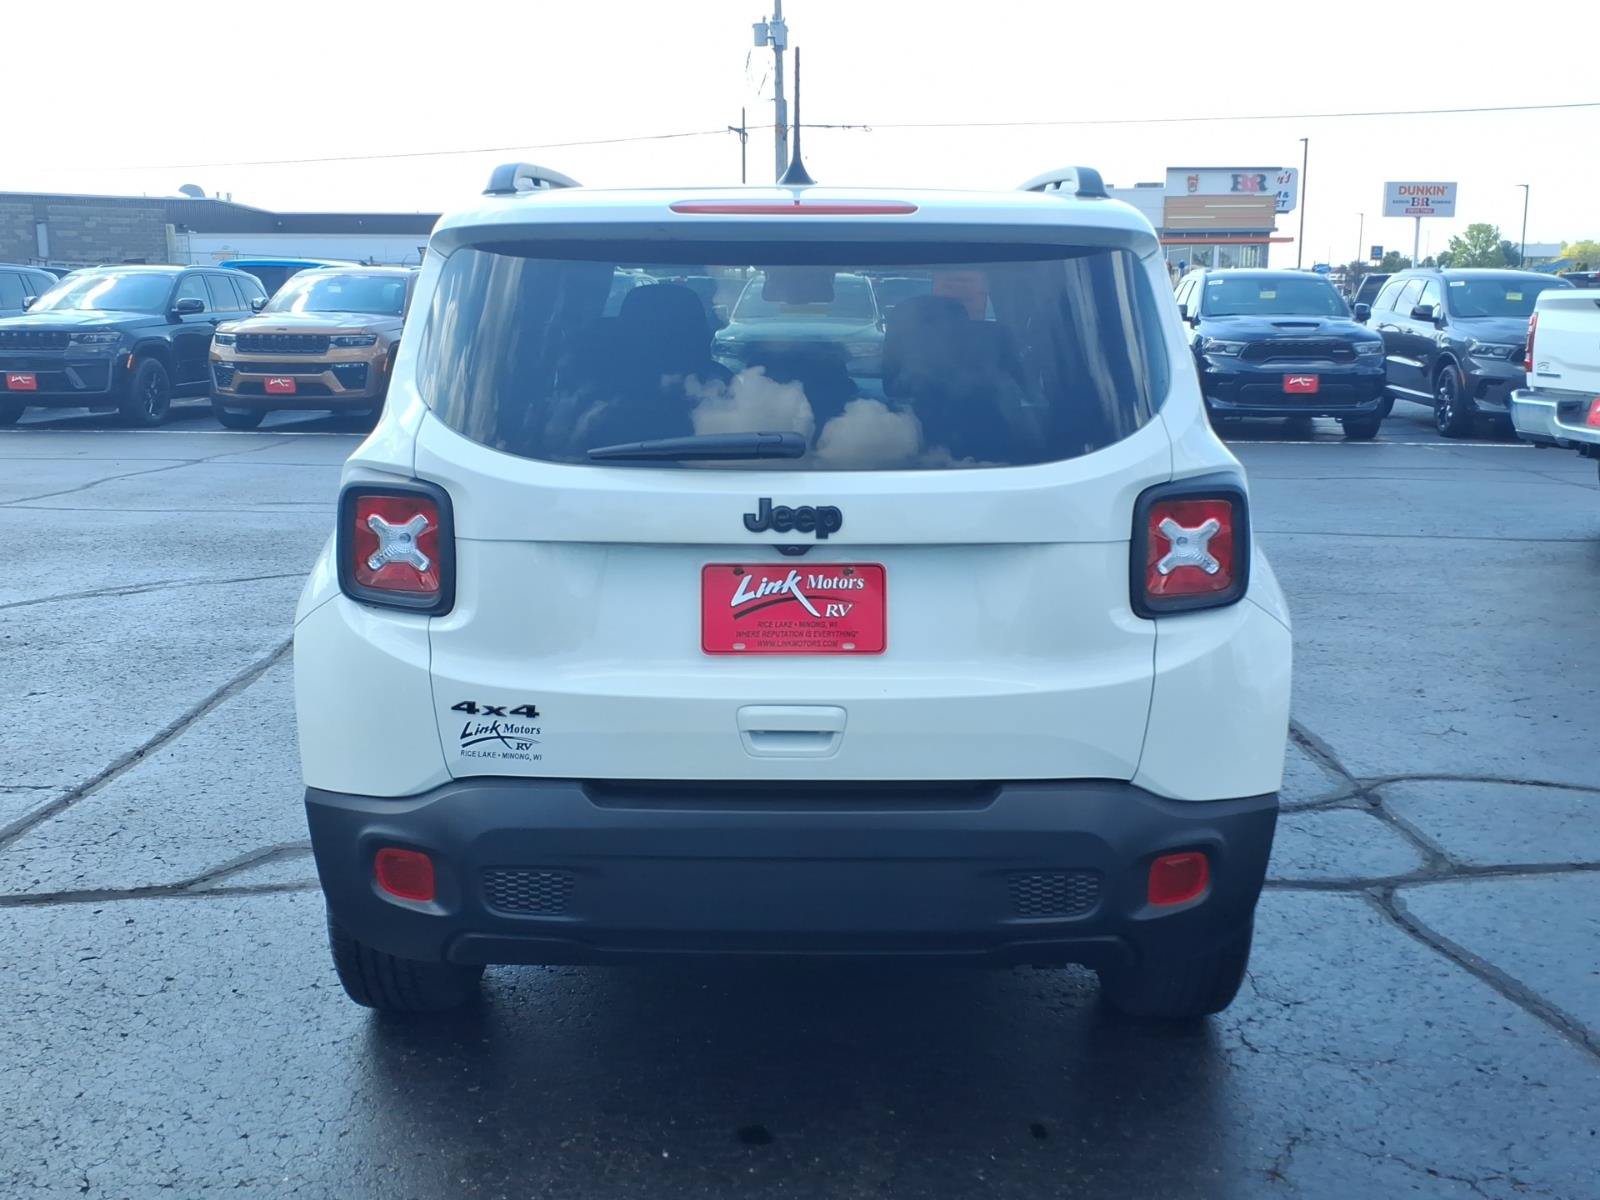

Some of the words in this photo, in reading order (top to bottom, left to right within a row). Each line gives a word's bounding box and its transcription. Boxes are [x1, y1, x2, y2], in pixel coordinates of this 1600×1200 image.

[1411, 197, 1430, 207] BR
[743, 497, 843, 540] Jeep
[730, 569, 821, 618] Link
[806, 574, 865, 590] Motors
[825, 604, 852, 617] RV
[774, 621, 793, 629] LAKE
[761, 630, 804, 638] REPUTATION
[805, 630, 812, 638] IS
[451, 700, 540, 718] 4x4
[460, 719, 513, 750] Link
[503, 723, 541, 735] Motors
[516, 742, 533, 751] RV
[461, 750, 477, 758] RICE
[477, 751, 497, 759] LAKE
